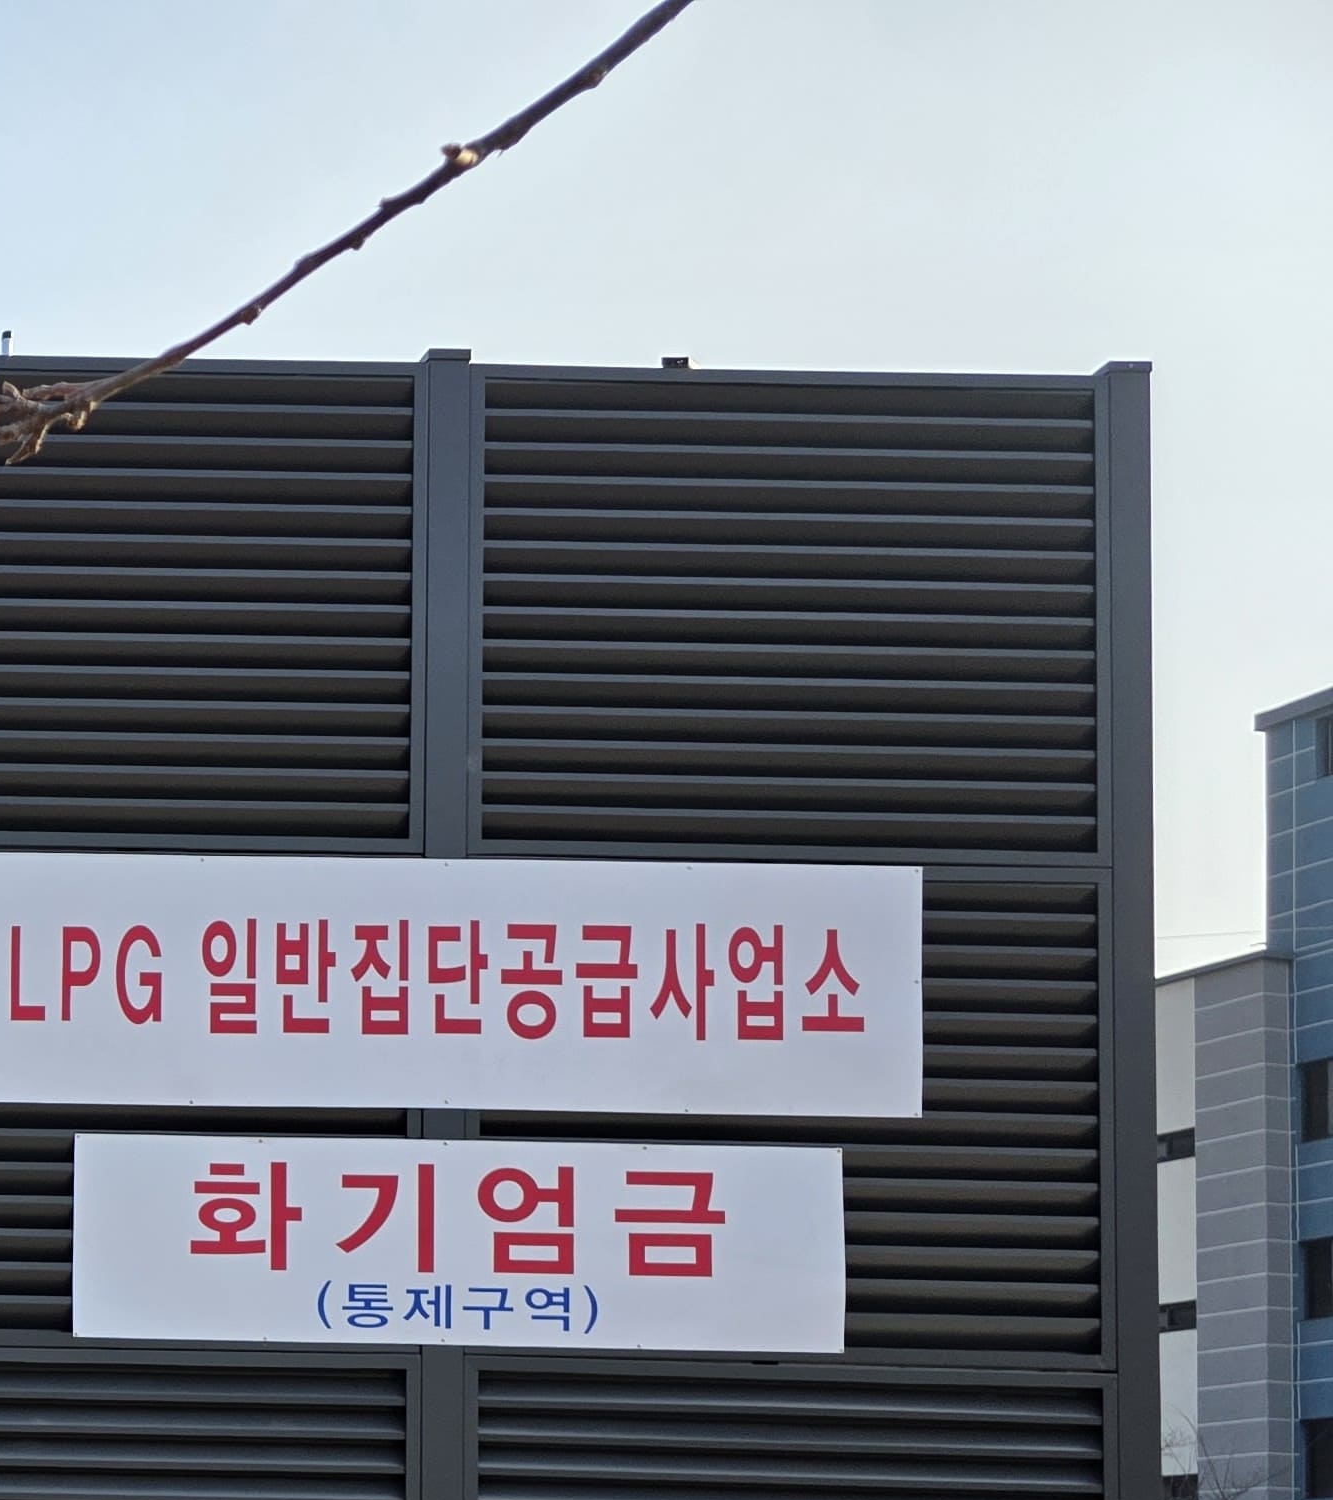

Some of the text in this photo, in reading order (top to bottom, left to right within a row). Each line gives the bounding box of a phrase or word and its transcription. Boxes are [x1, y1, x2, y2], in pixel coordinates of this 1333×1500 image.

[10, 918, 864, 1040] LPG 일반집단공급사업소
[189, 1161, 726, 1278] 화기엄금
[318, 1280, 597, 1334] (통제구역)
